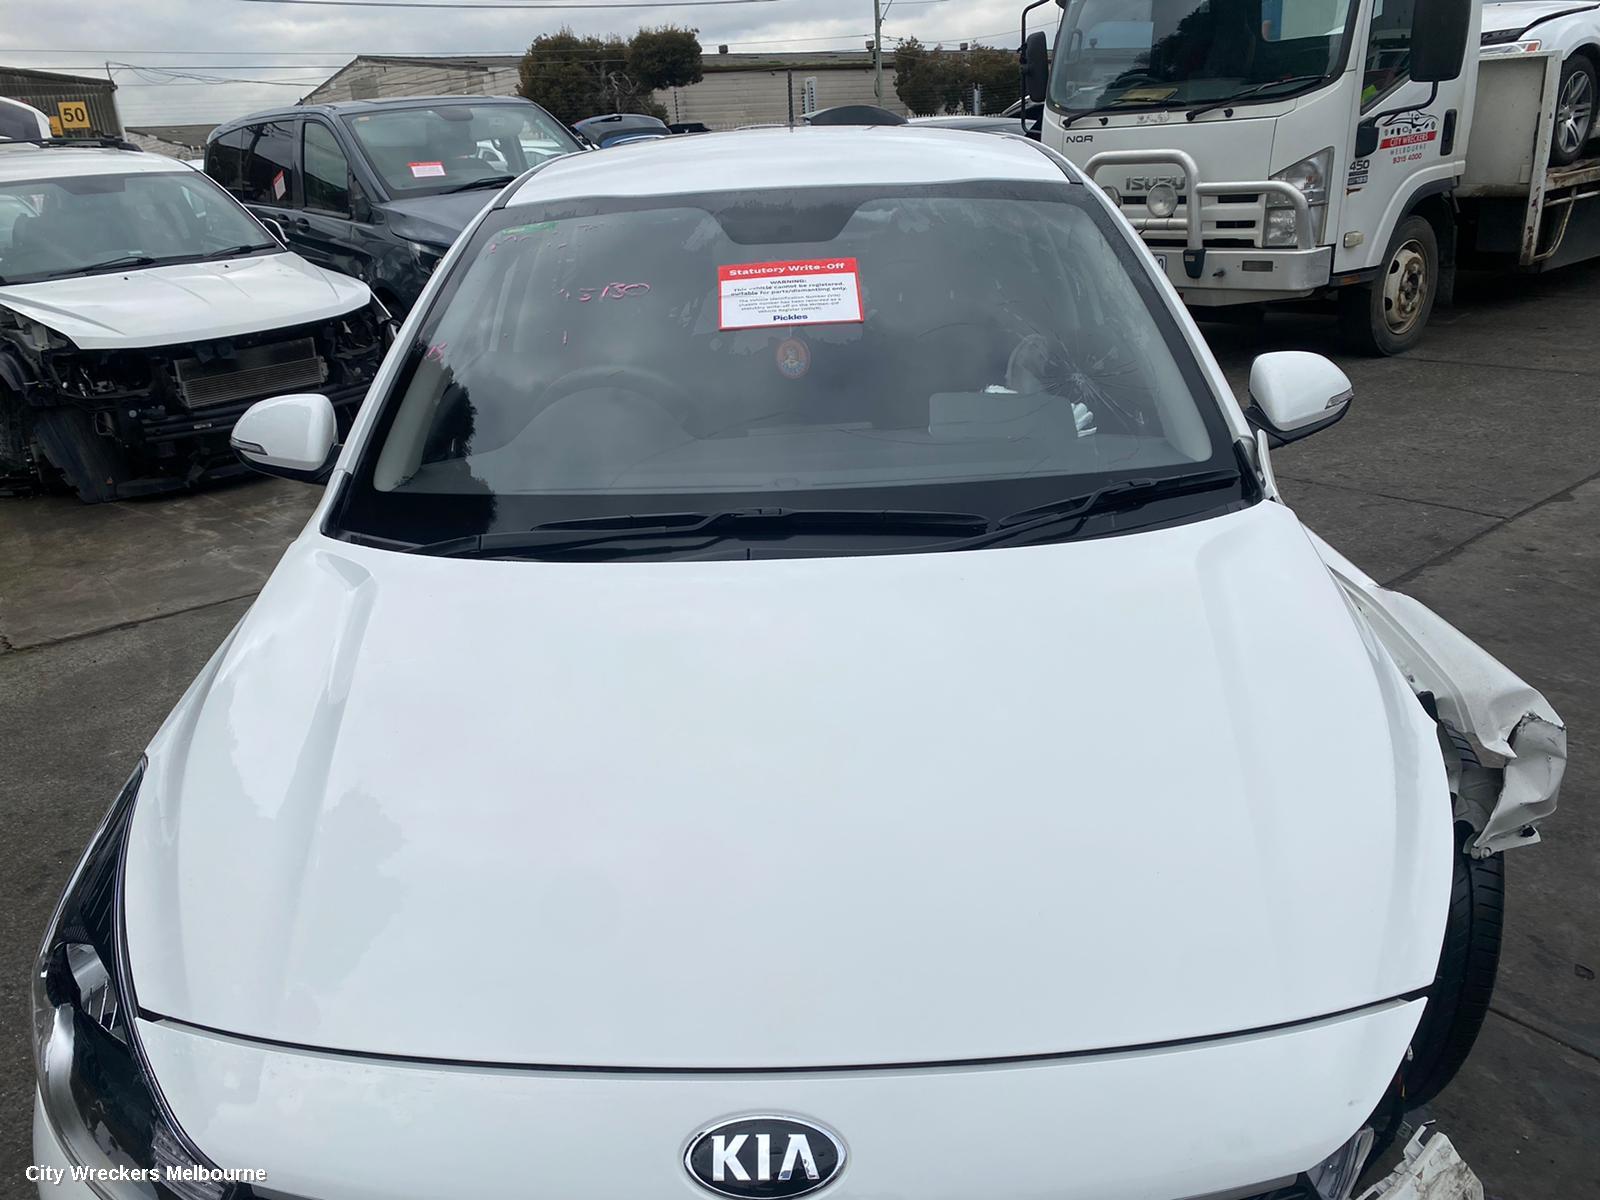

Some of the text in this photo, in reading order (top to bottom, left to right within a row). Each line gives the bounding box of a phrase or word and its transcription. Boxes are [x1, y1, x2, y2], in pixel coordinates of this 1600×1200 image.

[63, 107, 86, 122] 50
[1066, 135, 1094, 143] NQR
[1390, 133, 1428, 146] CITY WRECKERS
[1349, 159, 1370, 171] 450
[1126, 176, 1186, 191] ISUZU
[729, 262, 845, 276] Statutory Write-Off
[711, 1134, 820, 1182] KIA
